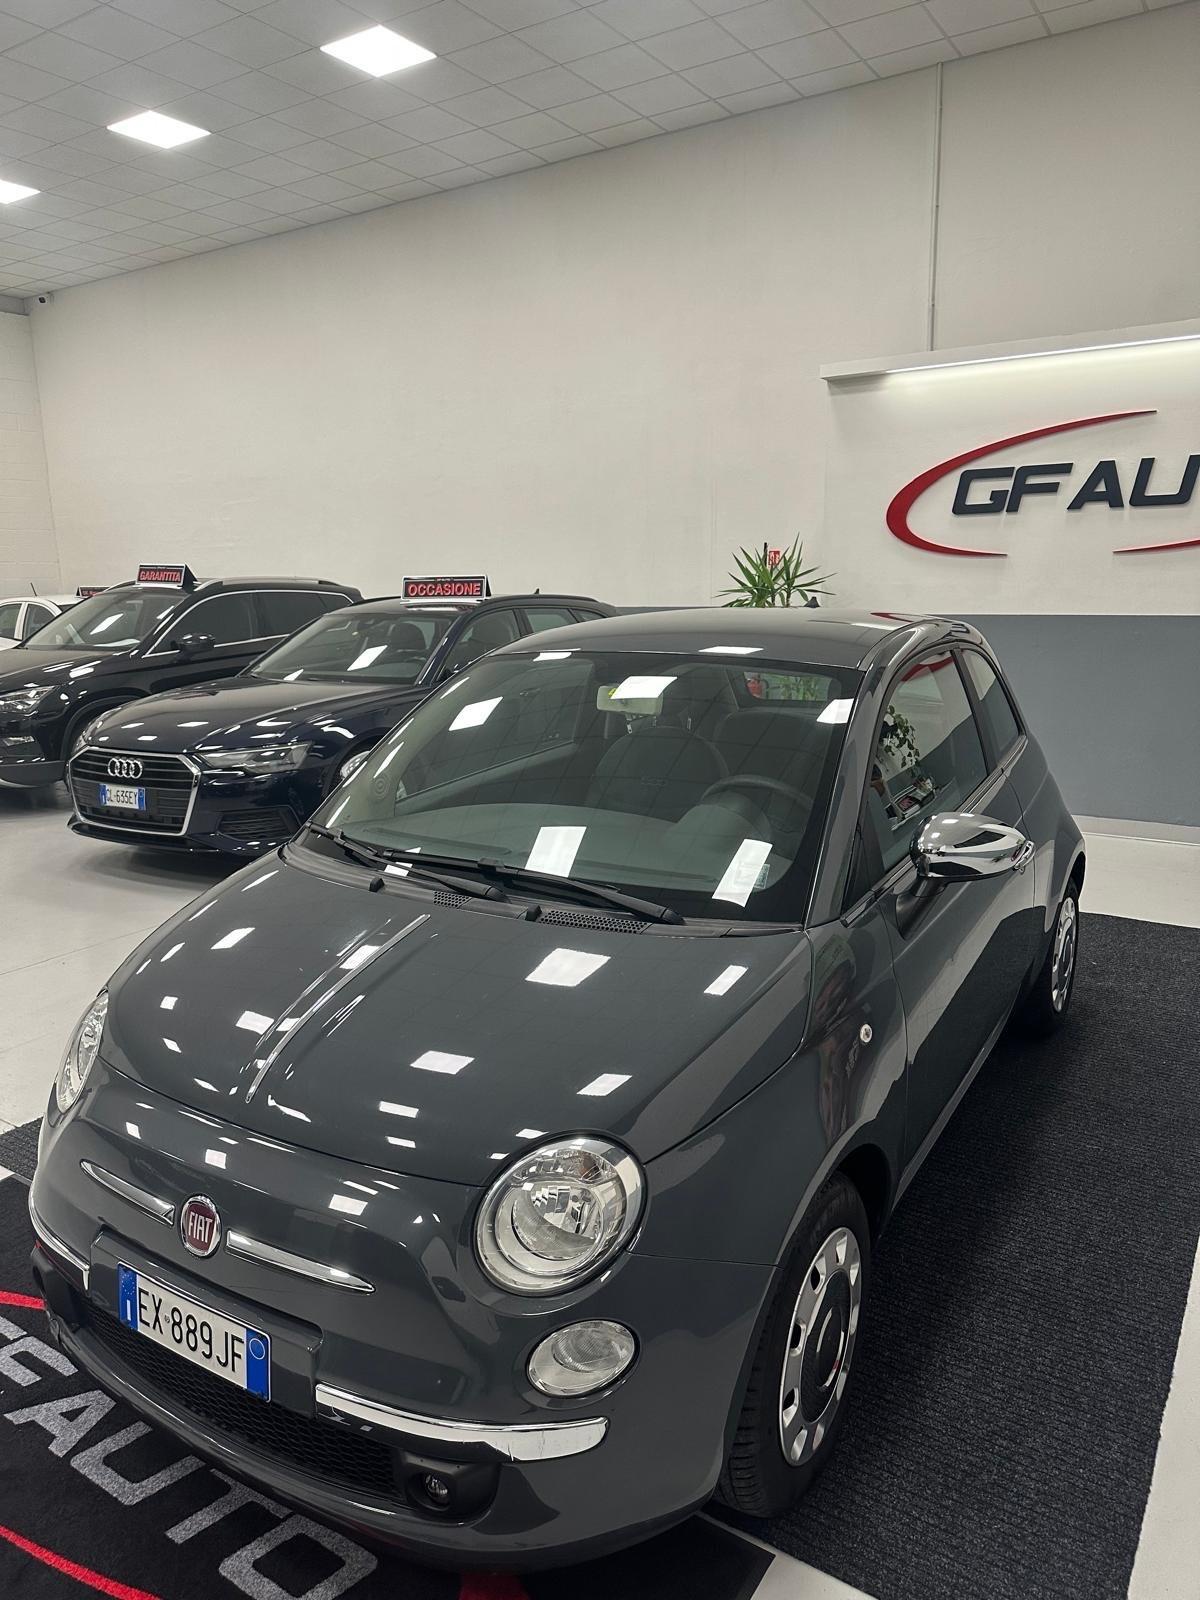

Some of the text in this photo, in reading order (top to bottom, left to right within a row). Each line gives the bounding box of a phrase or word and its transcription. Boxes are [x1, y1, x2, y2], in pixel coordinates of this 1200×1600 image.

[140, 570, 181, 581] GARANTITA
[408, 583, 481, 596] OCCASIONE
[188, 1211, 213, 1243] FIAT
